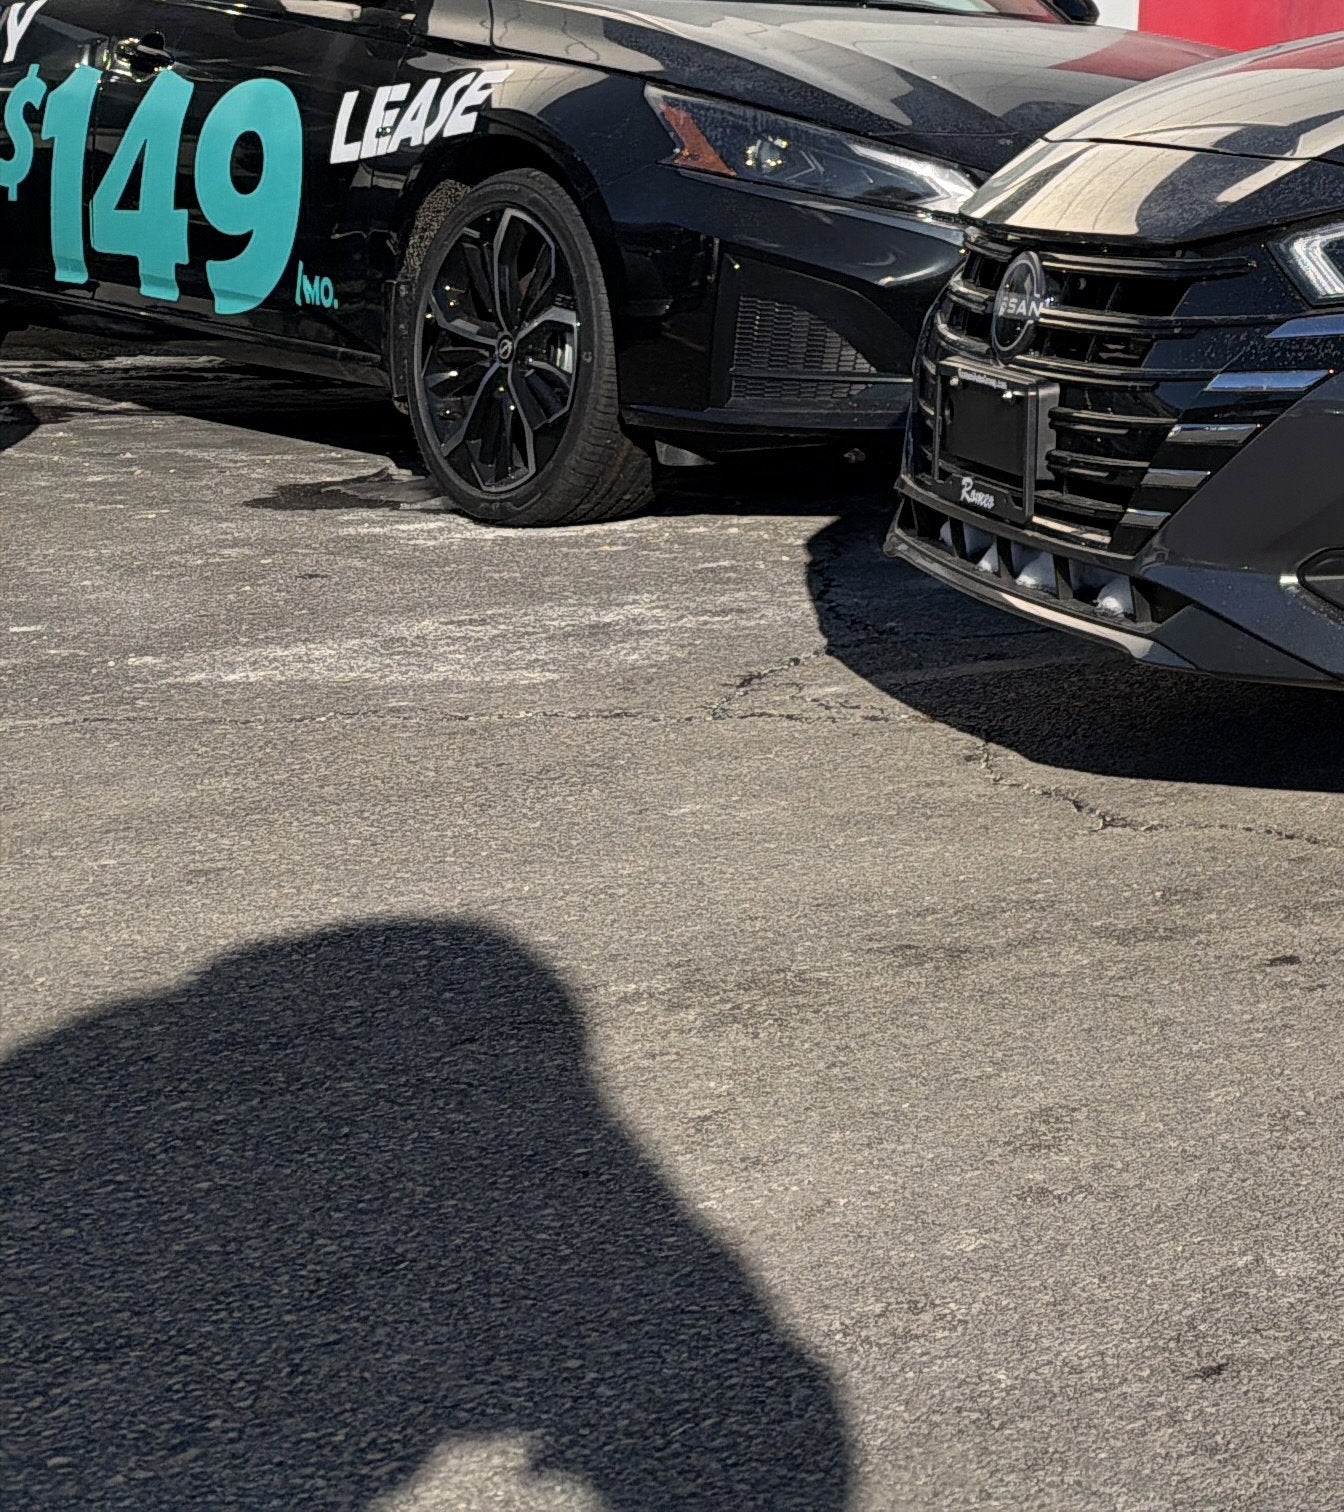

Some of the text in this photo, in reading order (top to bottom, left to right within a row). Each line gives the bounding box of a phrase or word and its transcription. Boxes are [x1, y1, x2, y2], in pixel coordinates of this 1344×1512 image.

[0, 64, 339, 315] $149 /MO.
[329, 69, 516, 165] LEASE
